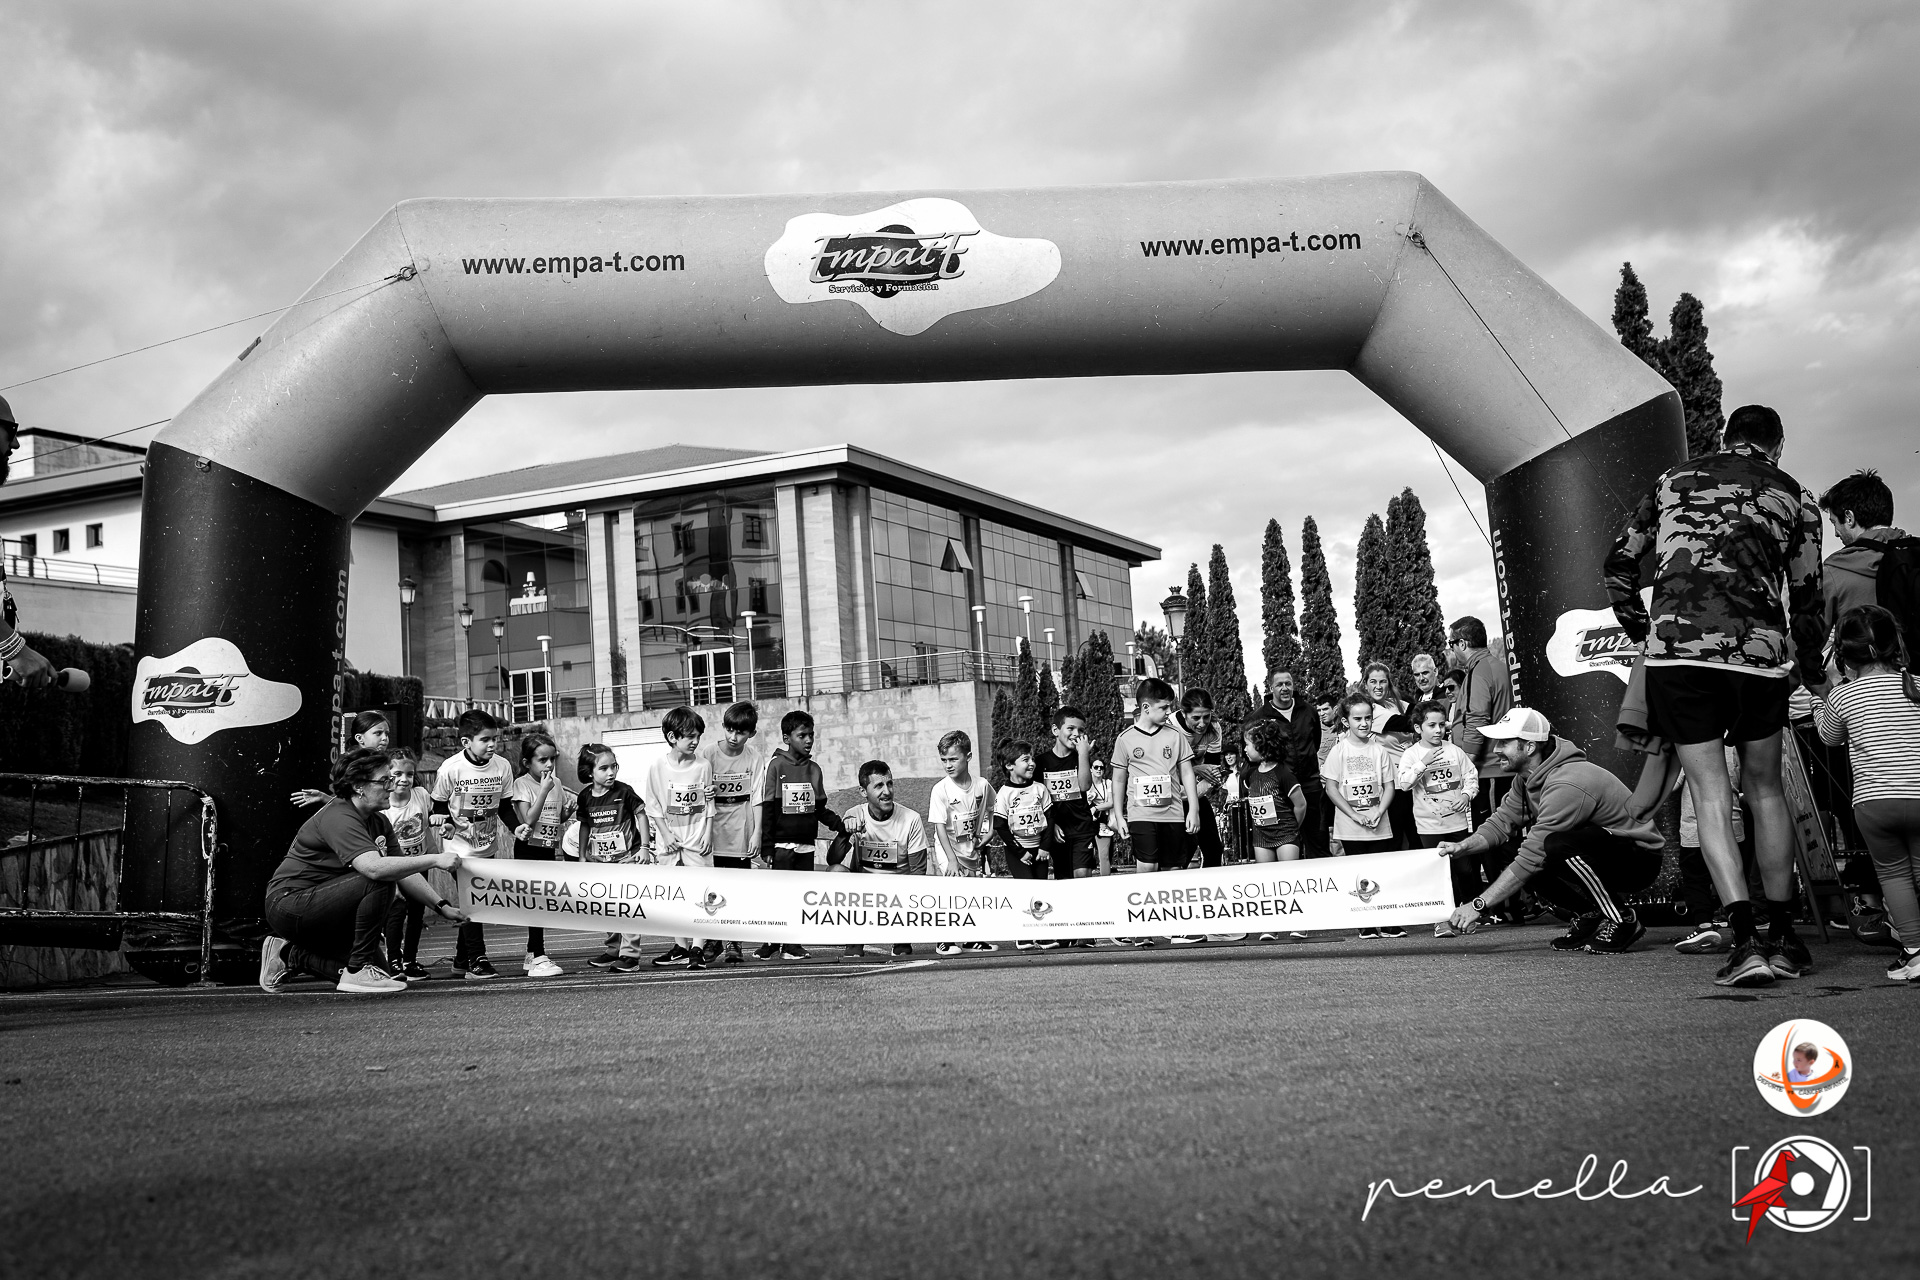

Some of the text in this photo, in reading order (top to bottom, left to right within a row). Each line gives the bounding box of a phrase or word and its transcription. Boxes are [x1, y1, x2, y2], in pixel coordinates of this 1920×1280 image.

[1140, 231, 1361, 259] www.empa-t.com
[462, 252, 685, 278] www.empa-t.com
[828, 282, 939, 294] Servicios y Formación
[1492, 529, 1522, 708] mpa-t.com
[1430, 768, 1452, 780] 336
[720, 782, 742, 792] 926
[1050, 780, 1072, 790] 328
[1143, 784, 1162, 794] 341
[1352, 784, 1374, 796] 332
[471, 795, 493, 805] 333
[676, 792, 698, 802] 340
[792, 792, 810, 802] 342
[963, 819, 977, 830] 33
[1018, 814, 1040, 825] 324
[540, 825, 558, 836] 335
[404, 843, 422, 856] 331
[597, 841, 616, 852] 334
[867, 849, 888, 858] 746
[470, 876, 686, 901] CARRERA SOLIDARIA
[1127, 878, 1338, 906] CARRERA SOLIDARIA
[470, 891, 646, 919] MANU BARRERA
[803, 890, 1013, 910] CARRERA SOLIDARIA
[1127, 898, 1304, 922] MANU BARRERA
[802, 909, 976, 926] MANU BARRERA
